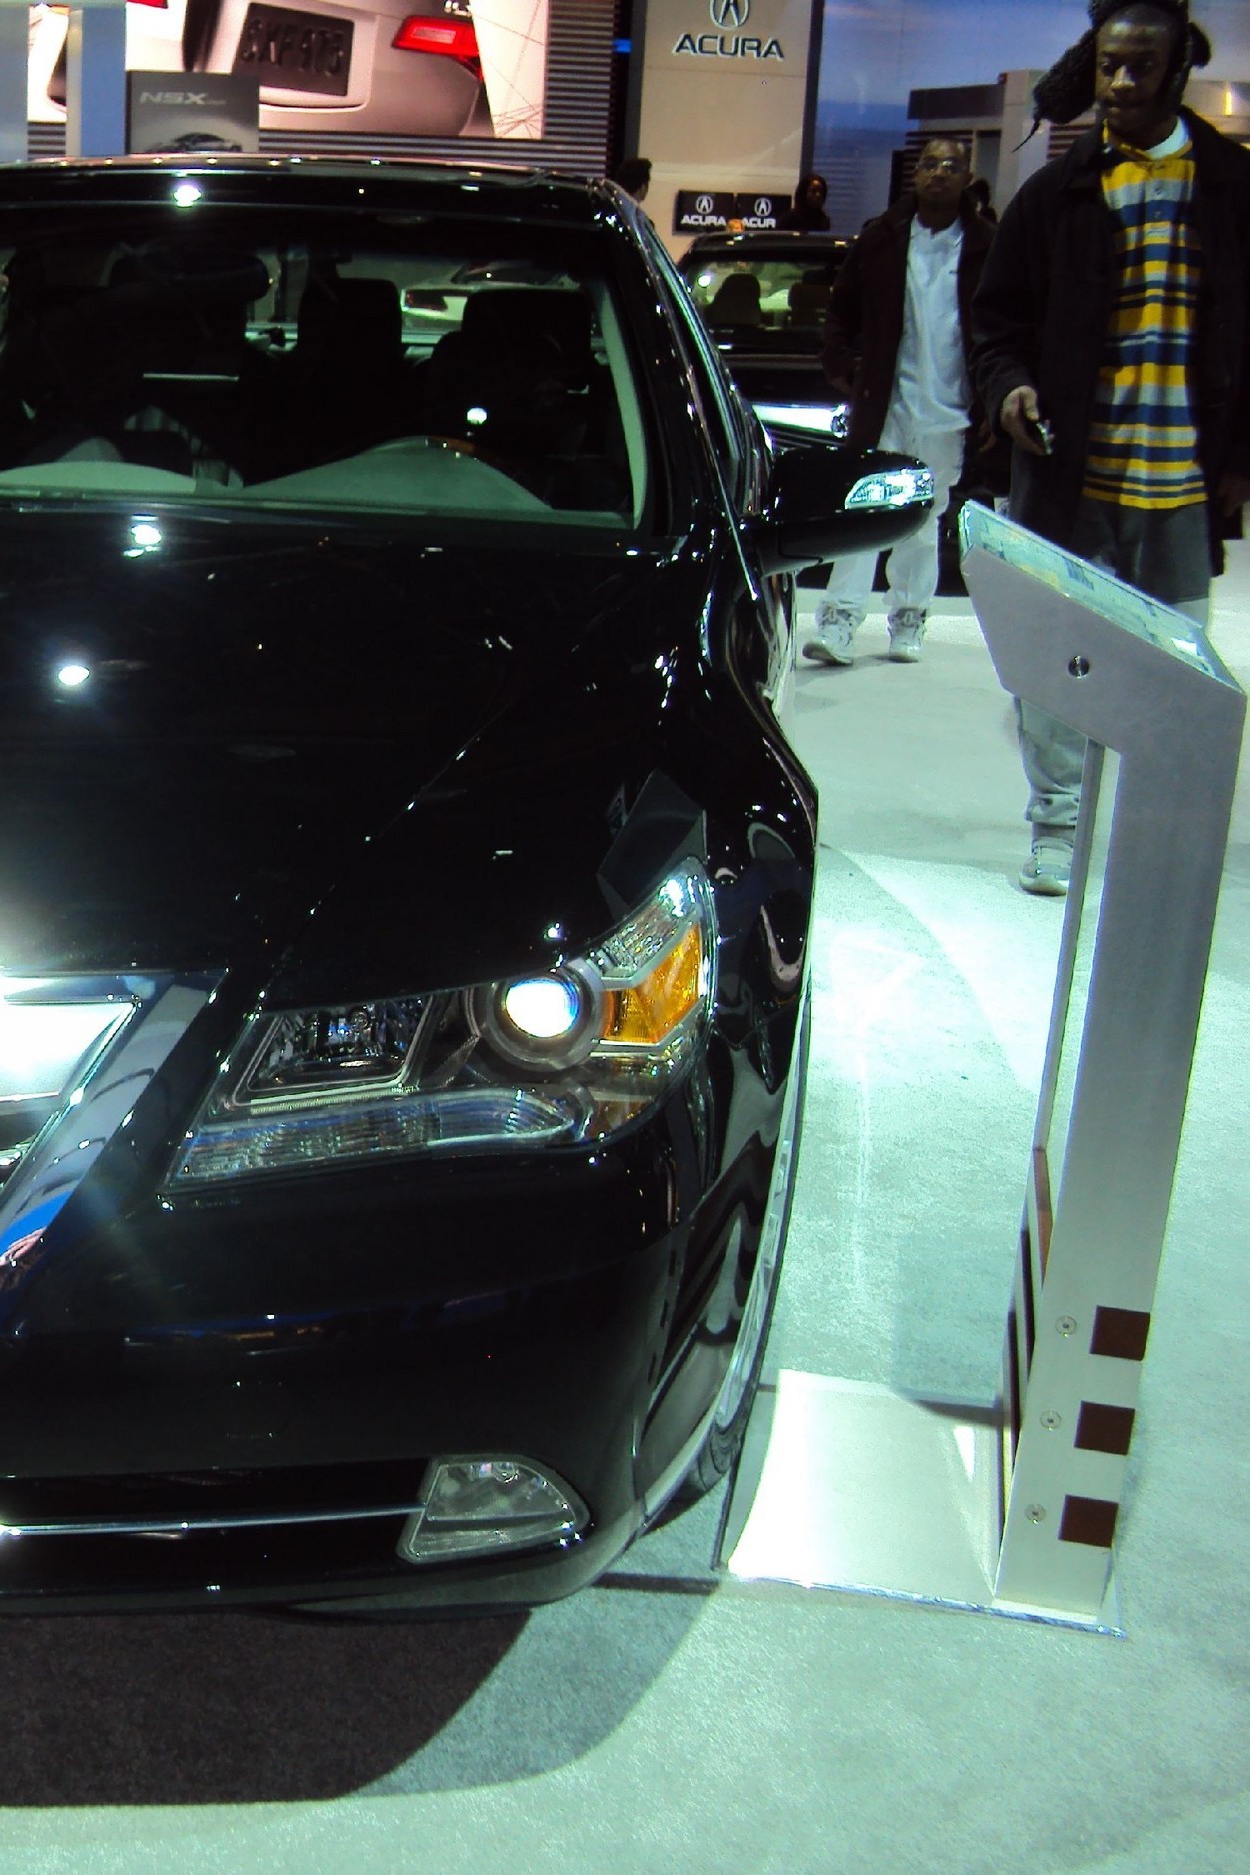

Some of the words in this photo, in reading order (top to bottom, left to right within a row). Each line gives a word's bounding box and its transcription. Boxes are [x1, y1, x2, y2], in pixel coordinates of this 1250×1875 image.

[672, 32, 785, 62] ACURA
[139, 91, 208, 104] NSX
[681, 213, 726, 227] ACURA
[741, 216, 777, 229] ACUR
